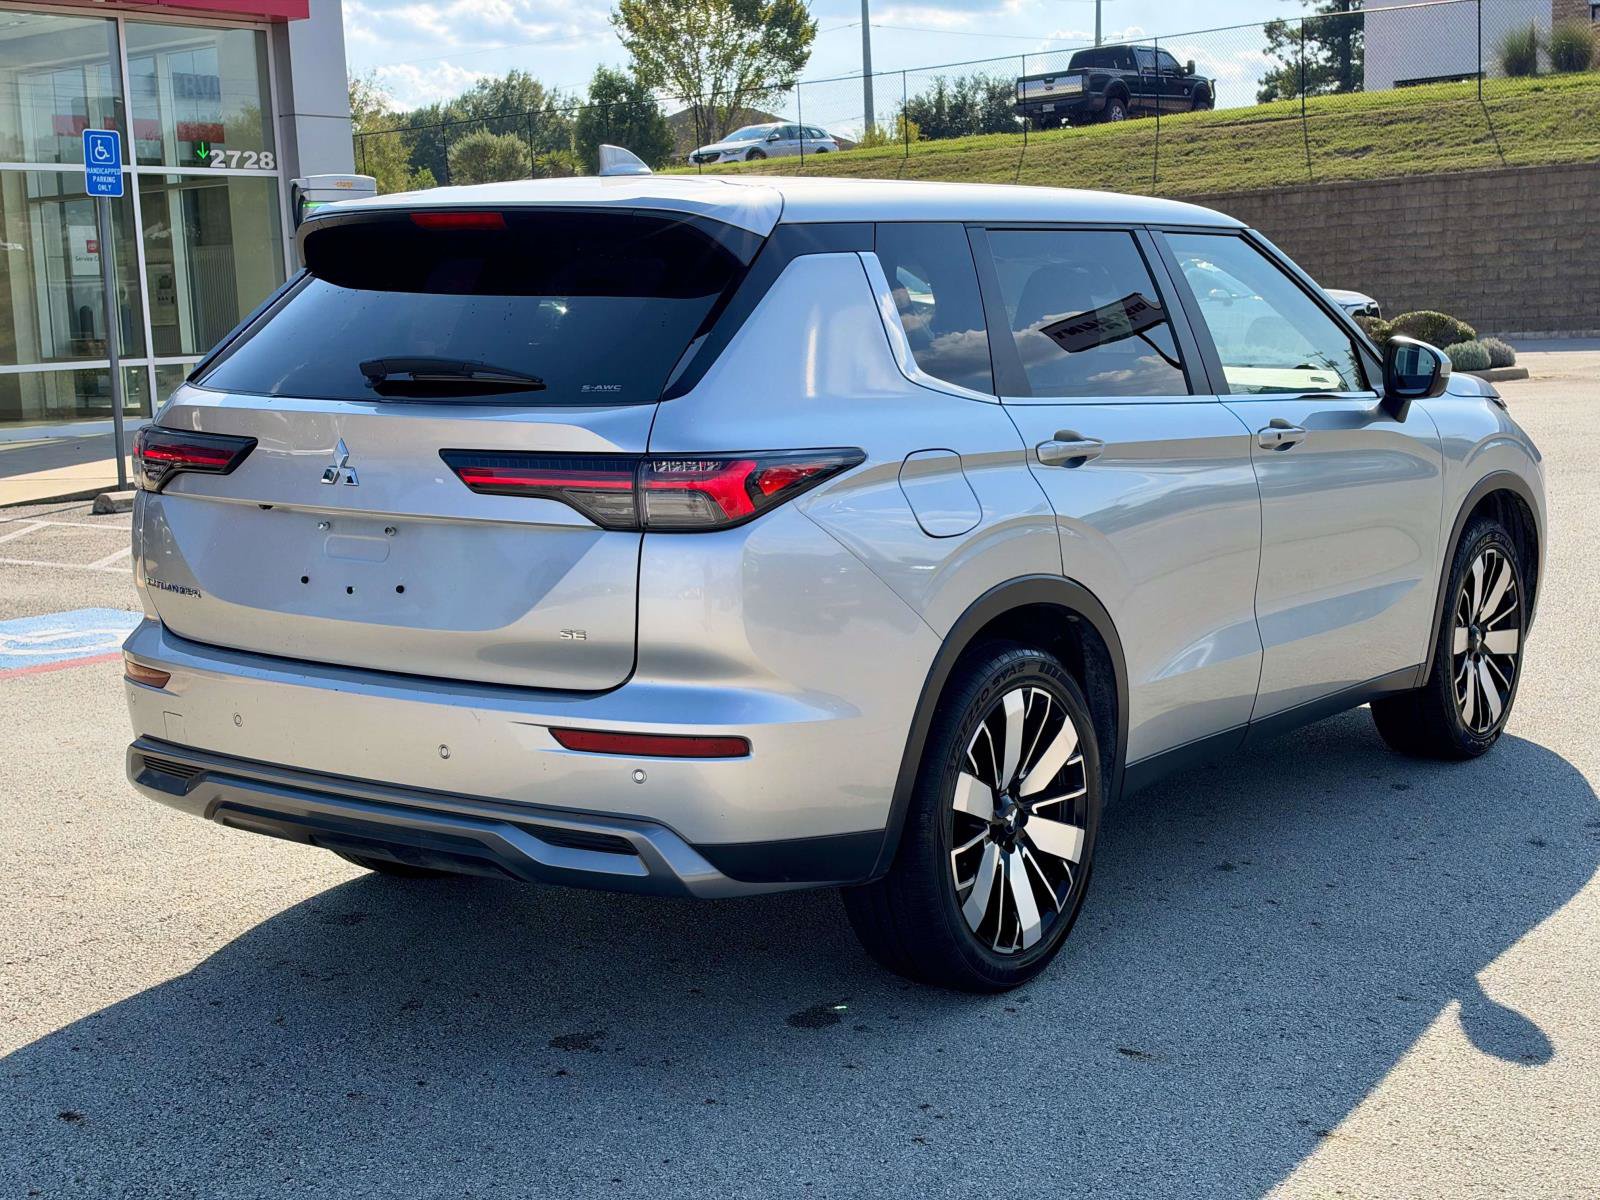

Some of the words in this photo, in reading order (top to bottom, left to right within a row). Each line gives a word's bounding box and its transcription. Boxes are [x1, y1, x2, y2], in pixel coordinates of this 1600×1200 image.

[209, 149, 275, 170] 2728
[87, 167, 121, 175] HANDICAPPED
[560, 630, 587, 640] SE
